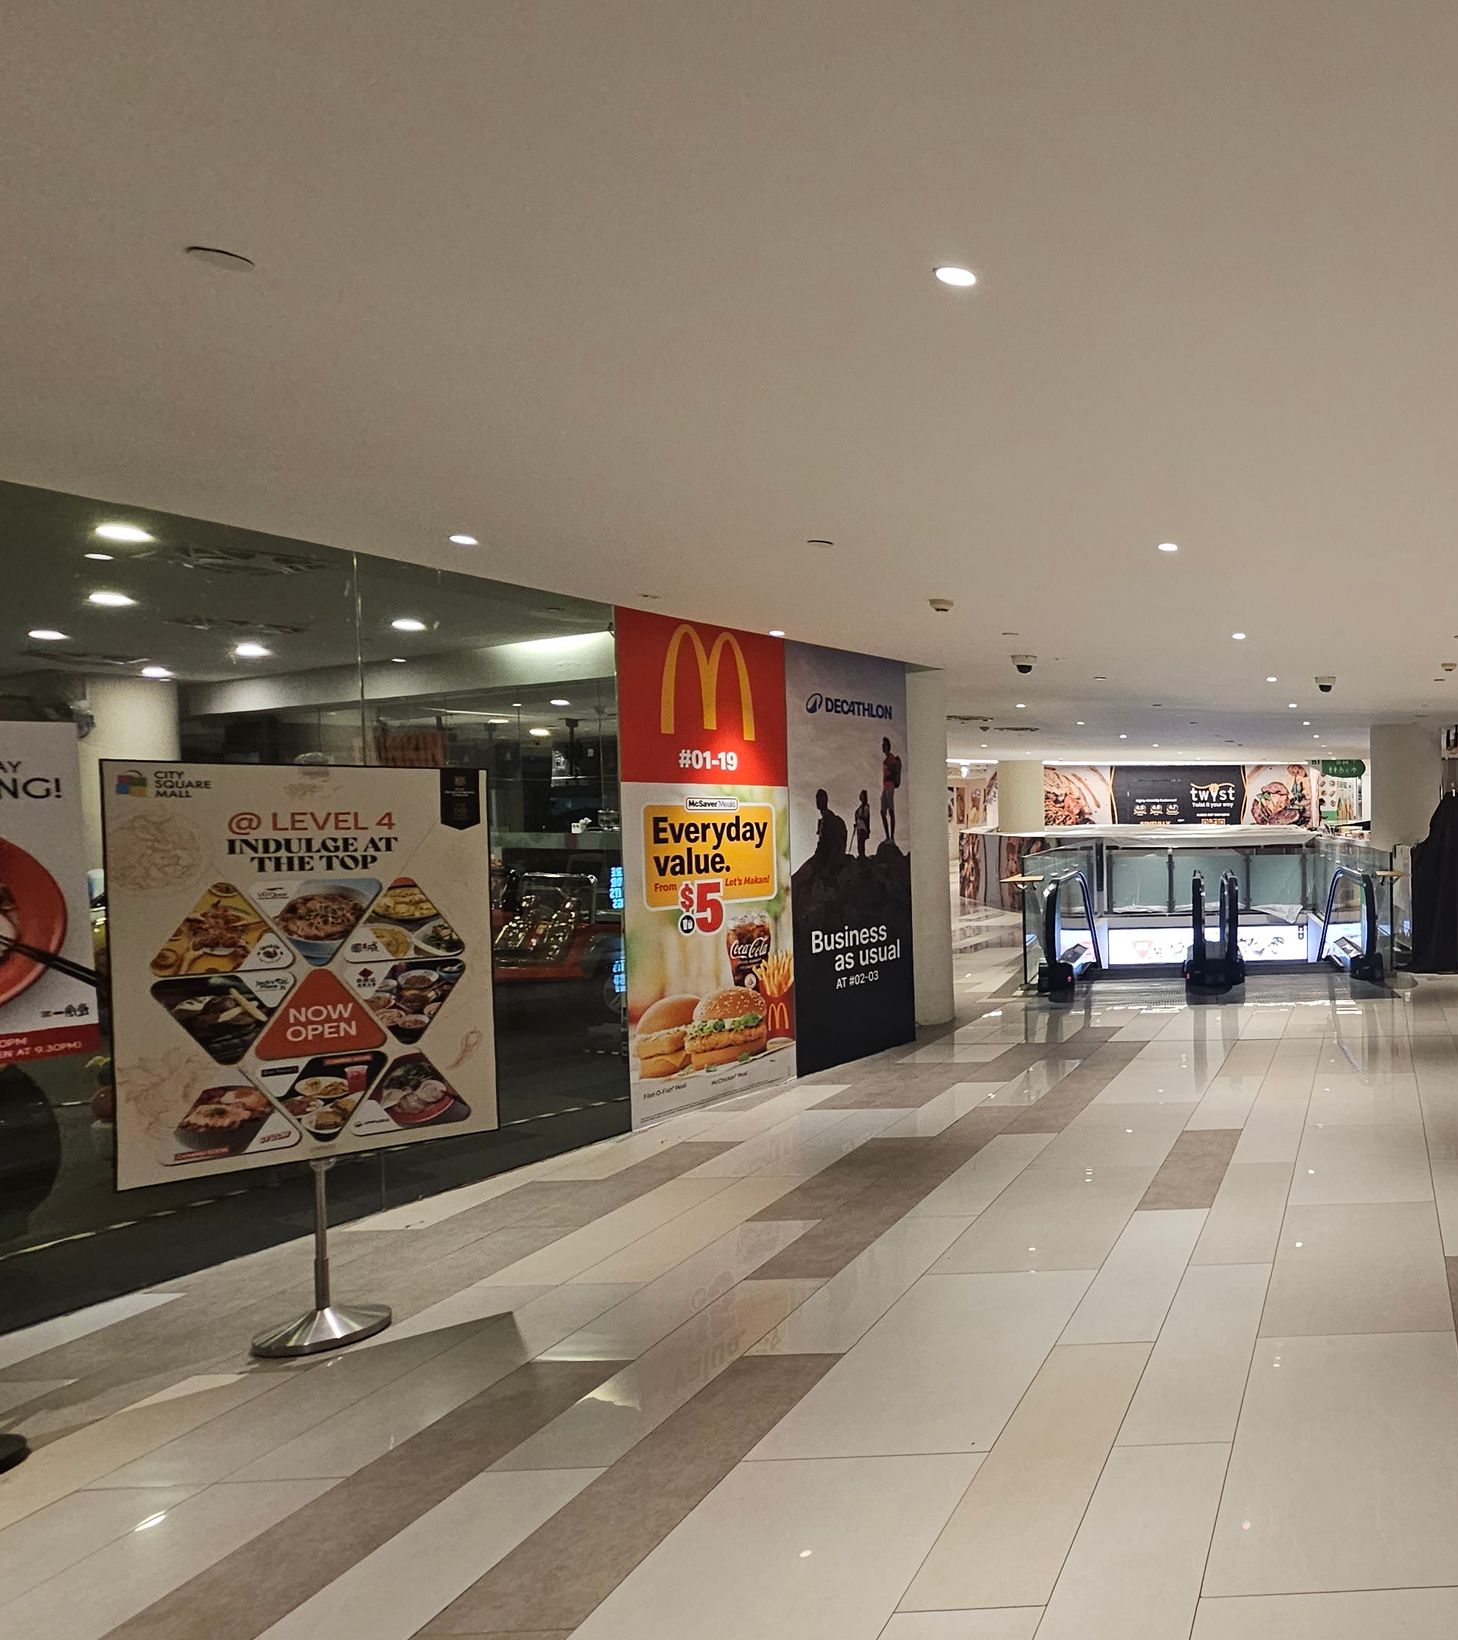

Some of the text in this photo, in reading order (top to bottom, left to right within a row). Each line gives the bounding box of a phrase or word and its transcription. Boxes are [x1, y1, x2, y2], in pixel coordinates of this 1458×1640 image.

[825, 697, 892, 719] DECATHLON
[679, 750, 738, 771] #01-19
[154, 771, 184, 779] CITY
[155, 780, 212, 789] SQUARE
[155, 790, 192, 798] MALL
[688, 800, 718, 808] McSaver
[228, 812, 395, 835] @ LEVEL 4
[652, 815, 768, 850] Everyday
[226, 837, 398, 855] INDULGE AT
[250, 855, 377, 872] THE TOP
[653, 847, 731, 877] value.
[654, 883, 677, 891] From
[725, 875, 770, 886] Let's Makan!
[680, 882, 724, 933] $5
[811, 925, 887, 953] Business
[835, 939, 900, 971] as usual
[836, 970, 879, 989] AT #02-03
[288, 1002, 354, 1023] NOW
[286, 1021, 357, 1042] OPEN
[16, 1047, 31, 1056] AT
